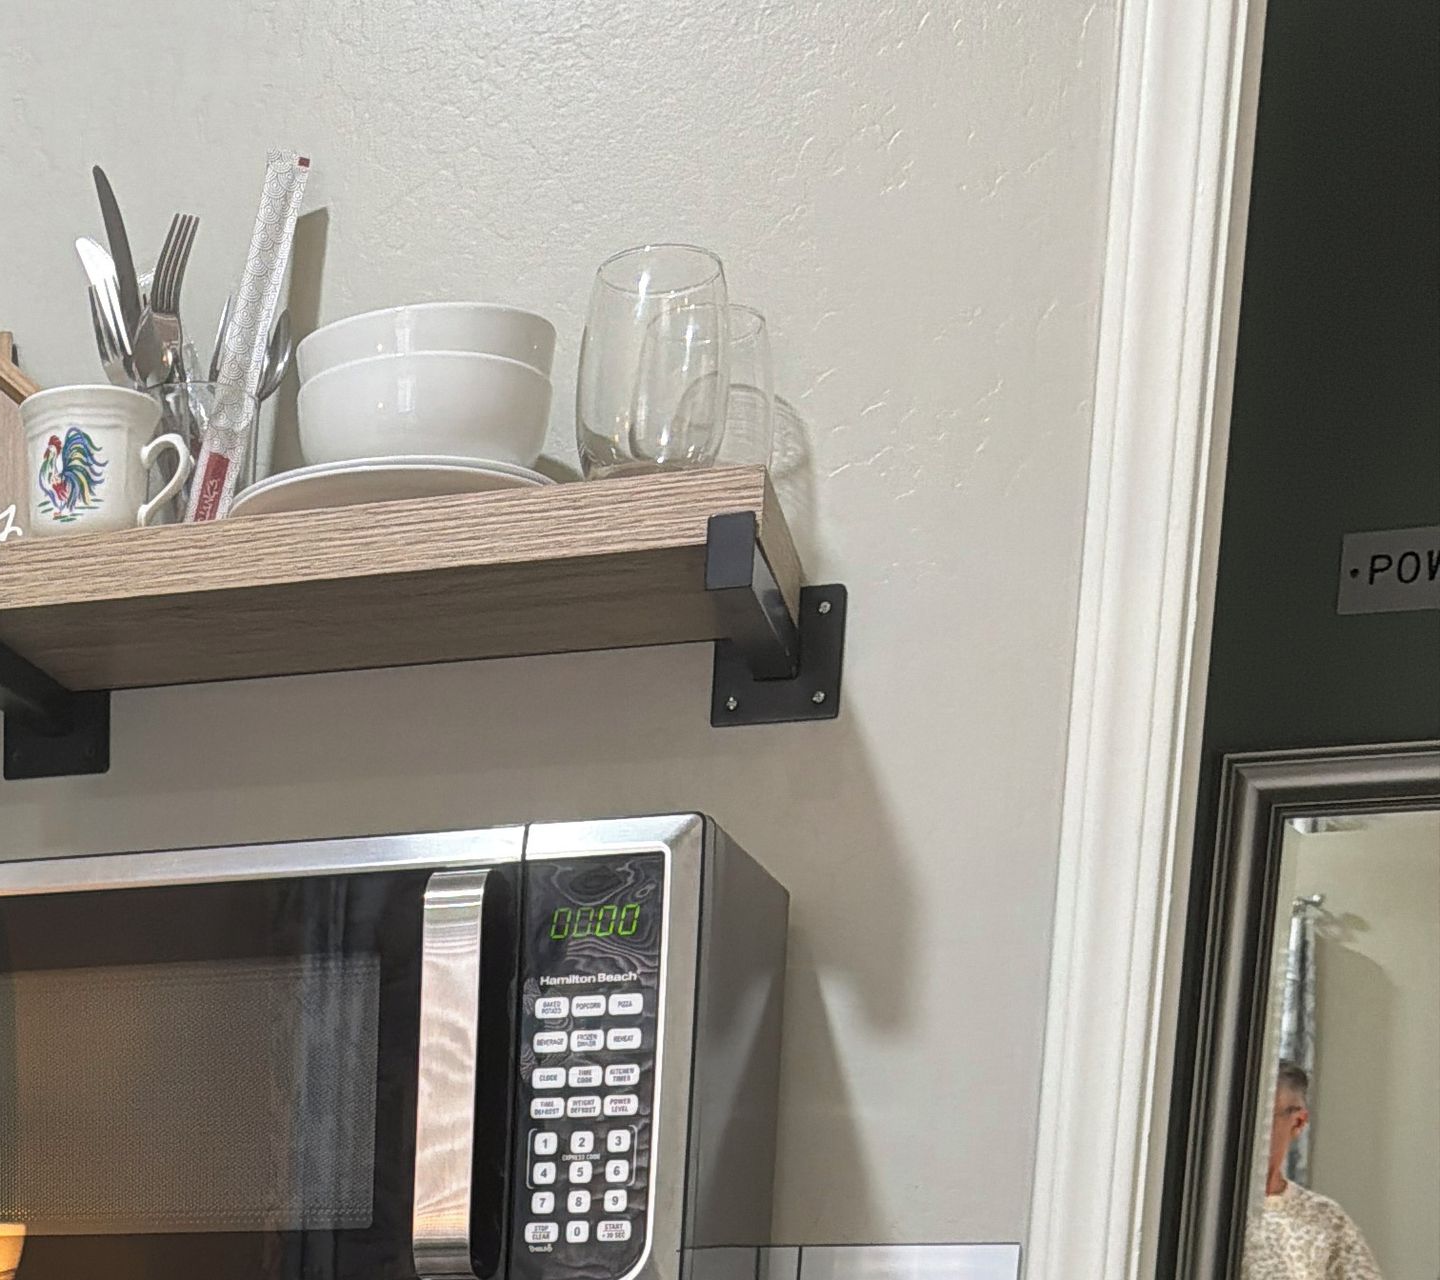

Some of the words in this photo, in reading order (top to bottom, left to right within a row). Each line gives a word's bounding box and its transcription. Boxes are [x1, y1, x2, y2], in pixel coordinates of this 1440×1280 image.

[540, 974, 596, 986] Hamilton
[597, 971, 638, 983] Beach
[542, 1000, 561, 1008] BAKED
[576, 1002, 602, 1010] POPCORN
[617, 1000, 633, 1008] PIZZA
[536, 1038, 564, 1046] BEVERAGE
[609, 1067, 635, 1075] KITCHEN
[539, 1074, 558, 1082] CLOCK
[570, 1106, 596, 1114] DEFROST
[542, 1138, 548, 1149] 1
[577, 1137, 585, 1147] 2
[615, 1136, 622, 1146] 3
[540, 1168, 547, 1178] 4
[576, 1167, 583, 1177] 5
[613, 1166, 620, 1176] 6
[539, 1198, 546, 1208] 7
[575, 1197, 582, 1207] 8
[611, 1196, 619, 1206] 9
[574, 1226, 580, 1237] 0
